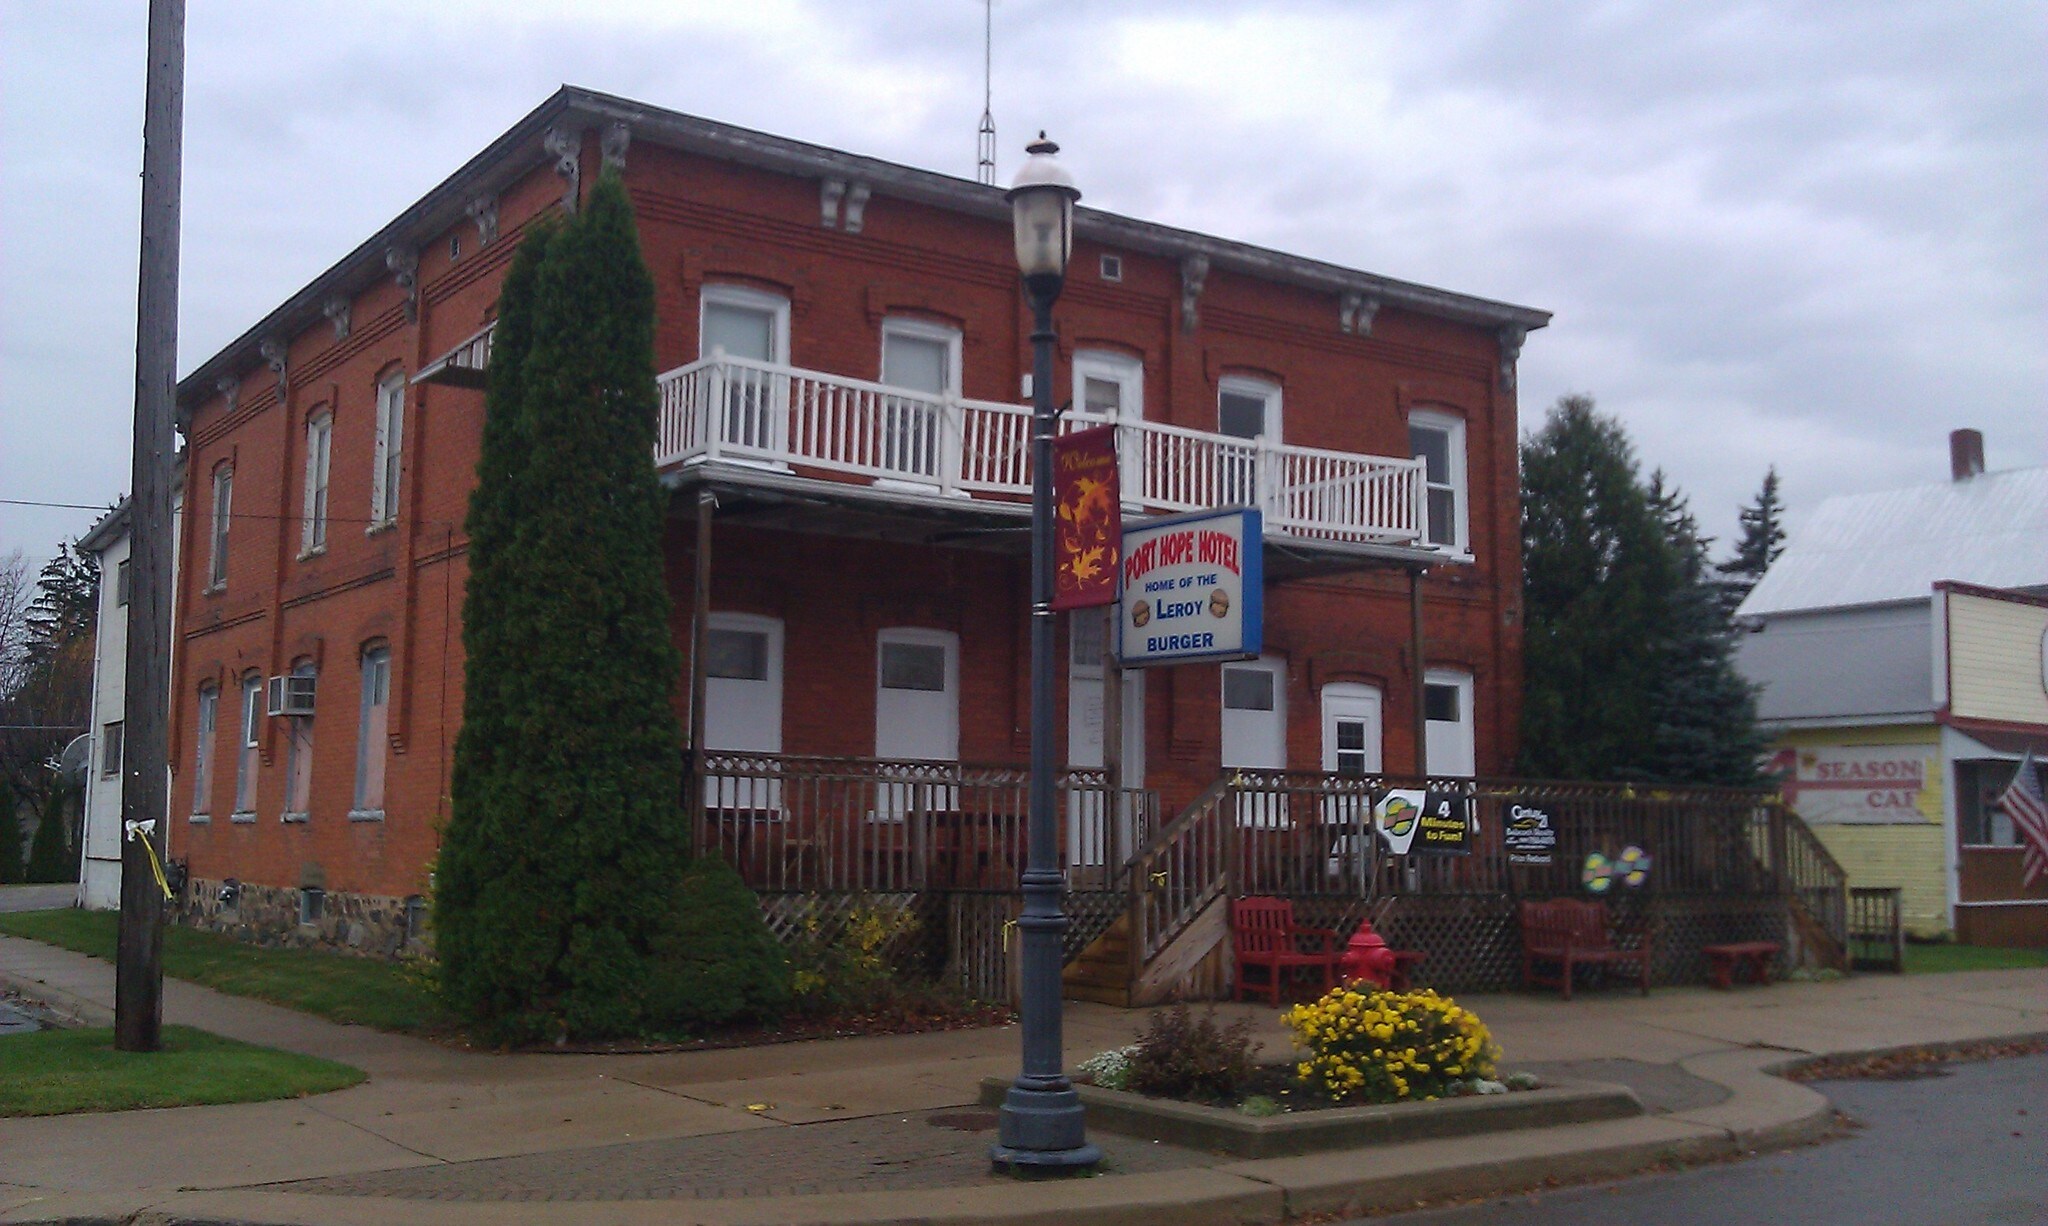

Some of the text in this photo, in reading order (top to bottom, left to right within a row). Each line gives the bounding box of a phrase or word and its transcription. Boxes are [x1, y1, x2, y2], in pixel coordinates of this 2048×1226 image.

[1061, 451, 1112, 471] Welcome
[1124, 529, 1240, 589] PORT HOPE HOTEL
[1145, 573, 1218, 593] HOME OF THE
[1147, 632, 1214, 652] BURGER
[1816, 760, 1922, 779] SEASON
[1437, 799, 1452, 818] 4
[1420, 817, 1466, 830] Minutes
[1425, 830, 1463, 842] to Fun!
